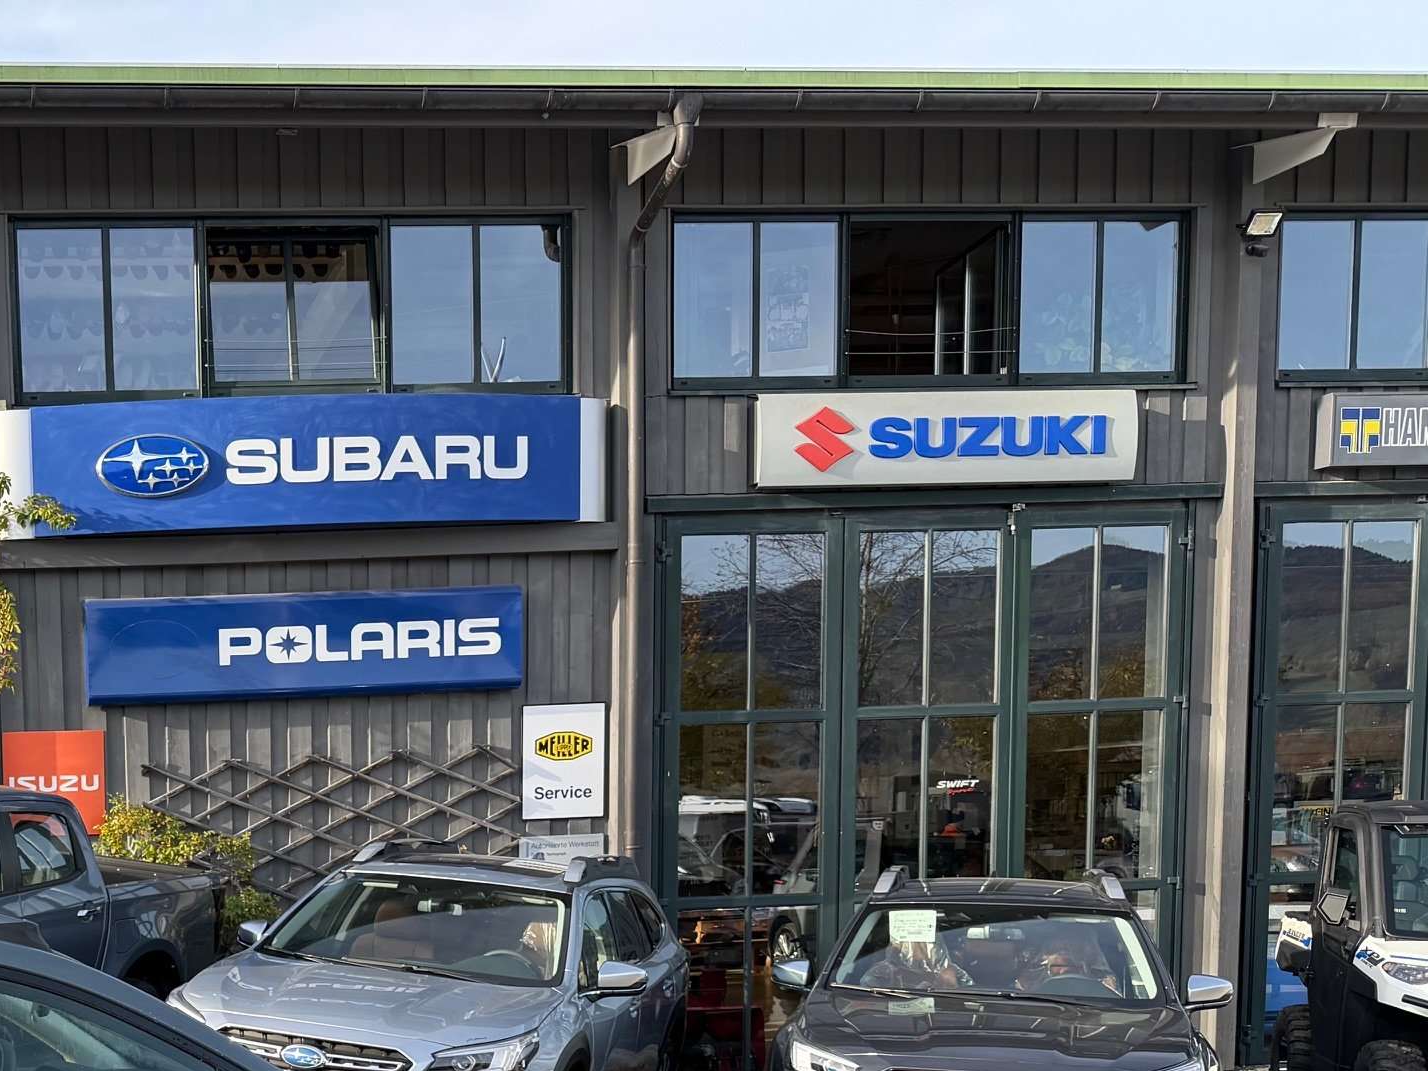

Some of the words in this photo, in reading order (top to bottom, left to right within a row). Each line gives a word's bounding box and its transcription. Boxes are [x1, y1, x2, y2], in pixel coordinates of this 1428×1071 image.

[868, 415, 1108, 458] SUZUKI
[225, 435, 529, 485] SUBARU
[218, 617, 502, 666] POLARIS
[538, 735, 590, 757] MEILLER
[8, 774, 100, 792] ISUZU
[534, 786, 593, 799] Service
[936, 779, 979, 789] SWIFT
